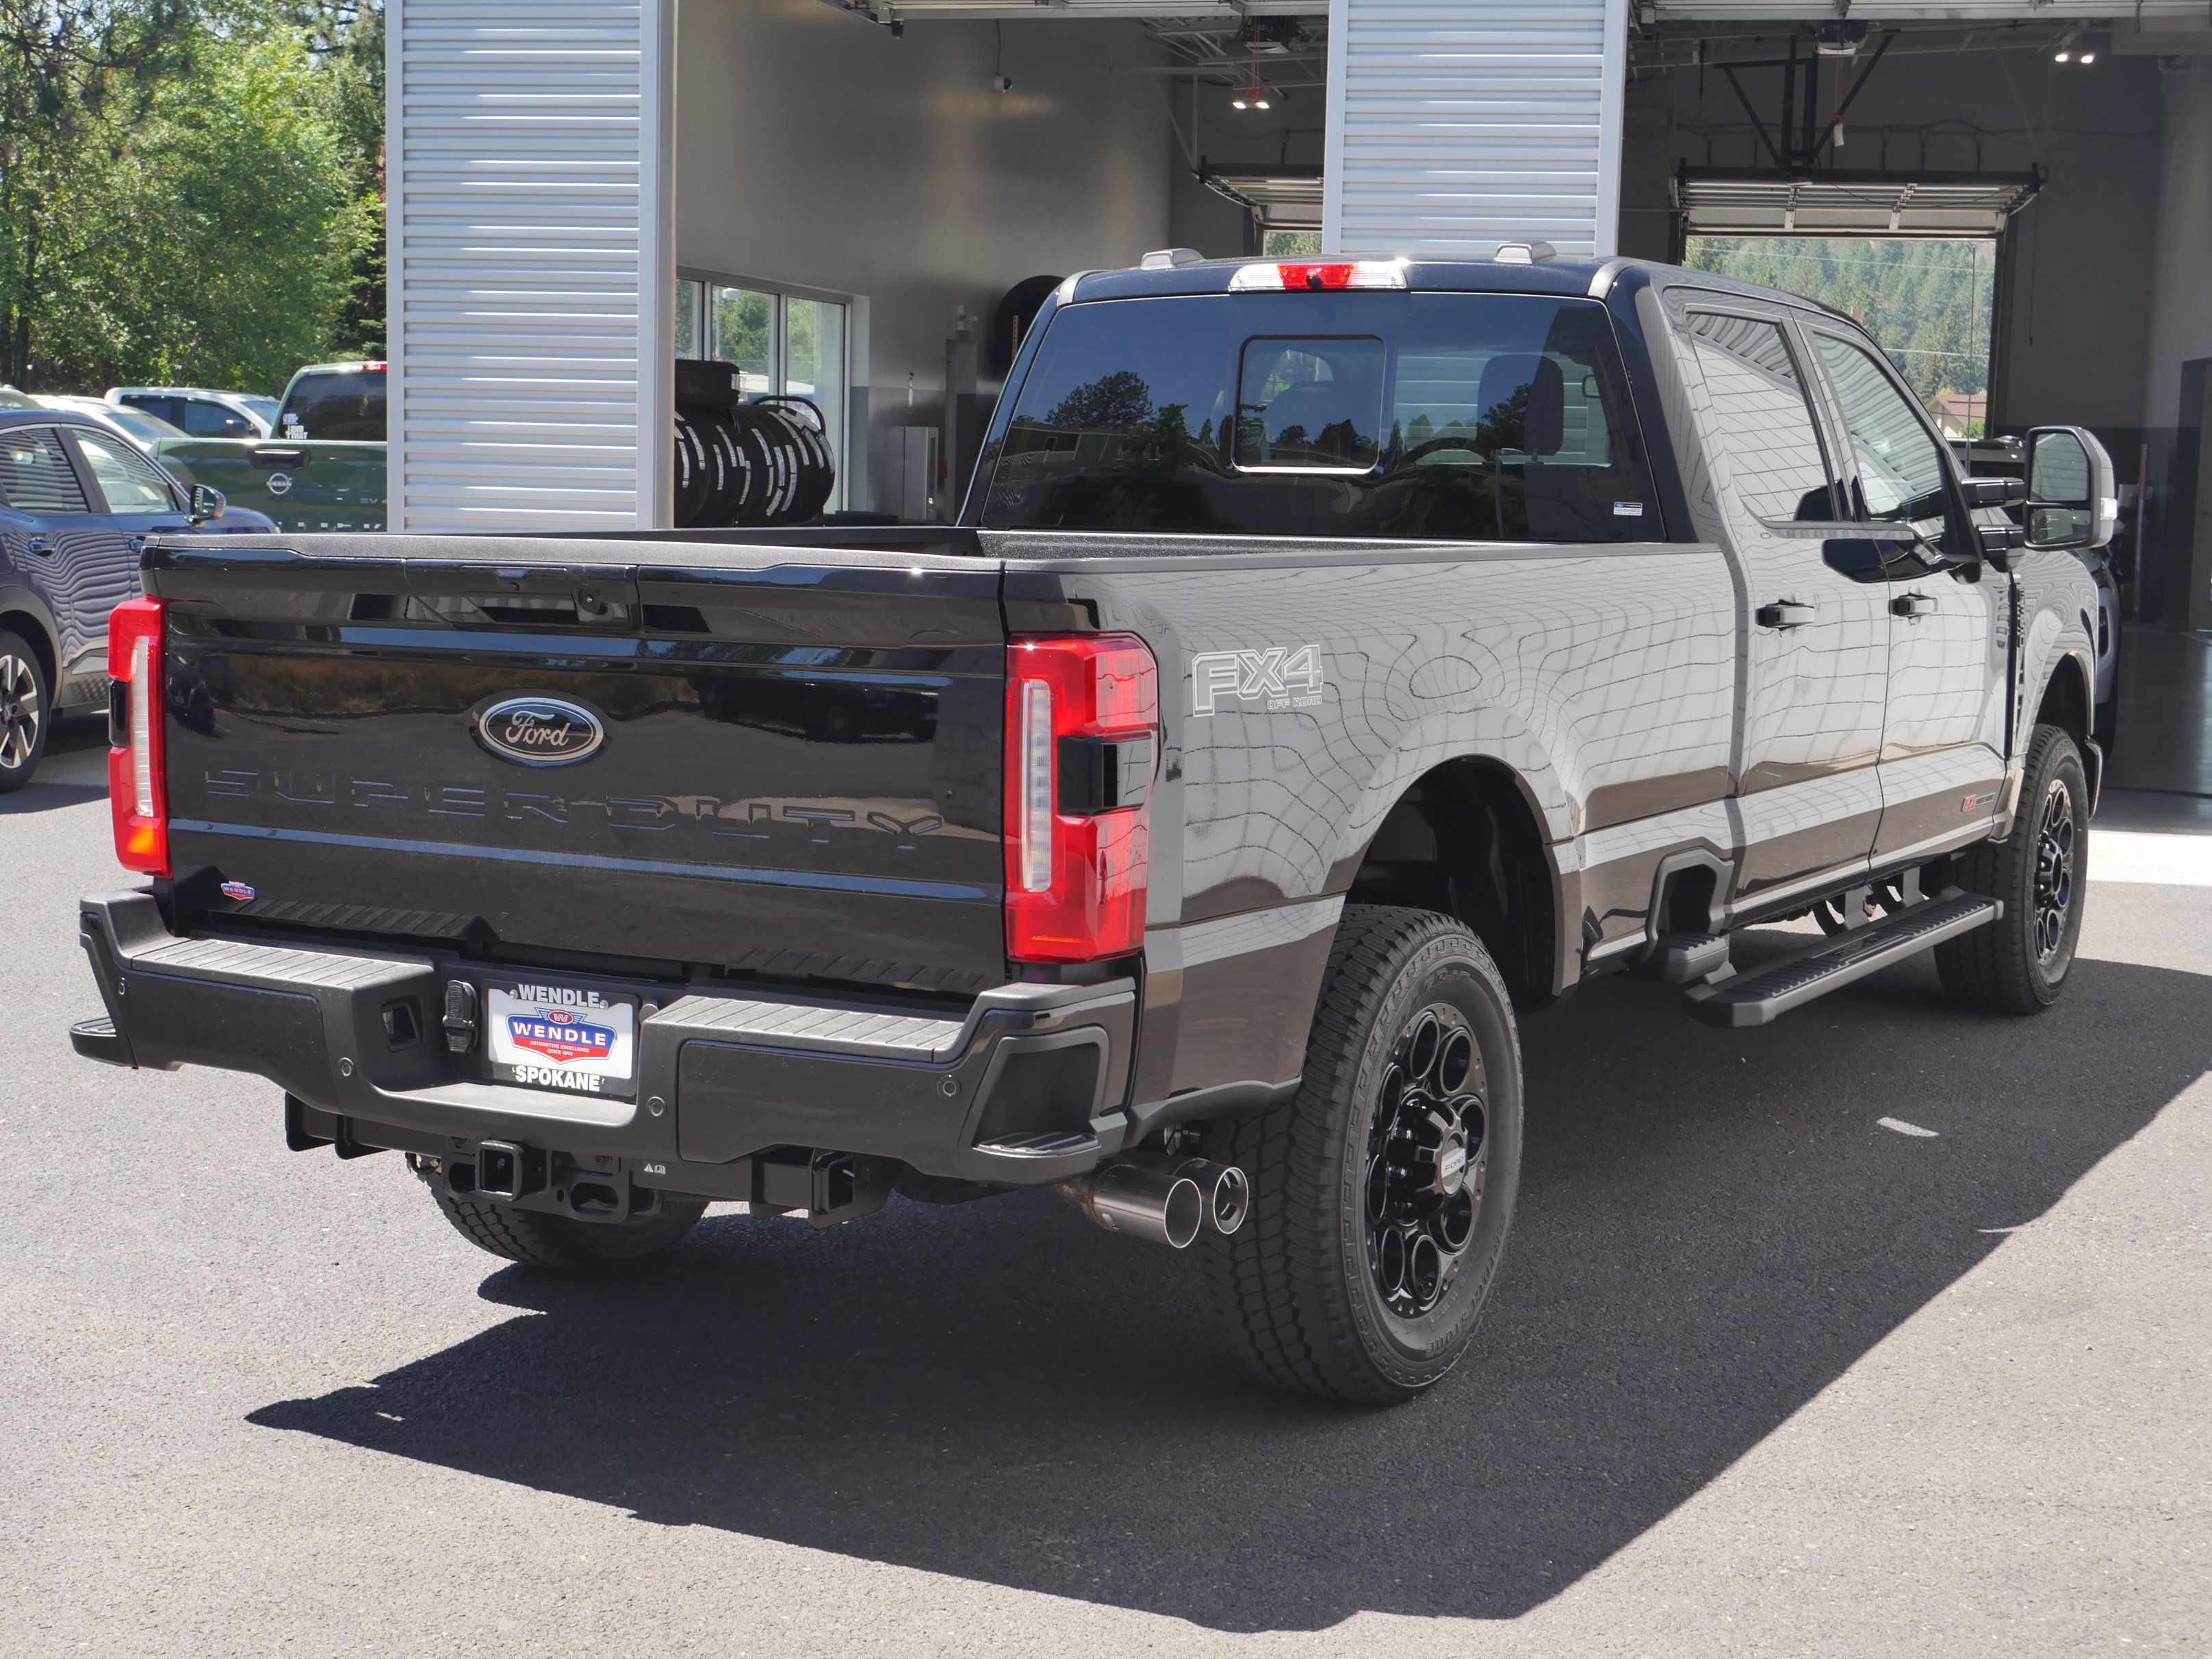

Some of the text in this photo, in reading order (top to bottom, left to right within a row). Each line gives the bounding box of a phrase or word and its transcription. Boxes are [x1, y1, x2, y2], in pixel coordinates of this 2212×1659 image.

[1192, 645, 1324, 717] FX4
[1268, 695, 1322, 710] OFF ROAD
[505, 710, 571, 747] Ford
[204, 768, 943, 849] SUPER DUTY
[222, 886, 252, 895] WENDLE
[517, 983, 600, 1008] WENDLE
[513, 1021, 606, 1046] WENDLE
[530, 1040, 590, 1053] AUTOMOTIVE EXCELLENCE
[515, 1065, 600, 1092] SPOKANE
[1445, 1156, 1463, 1172] FORD
